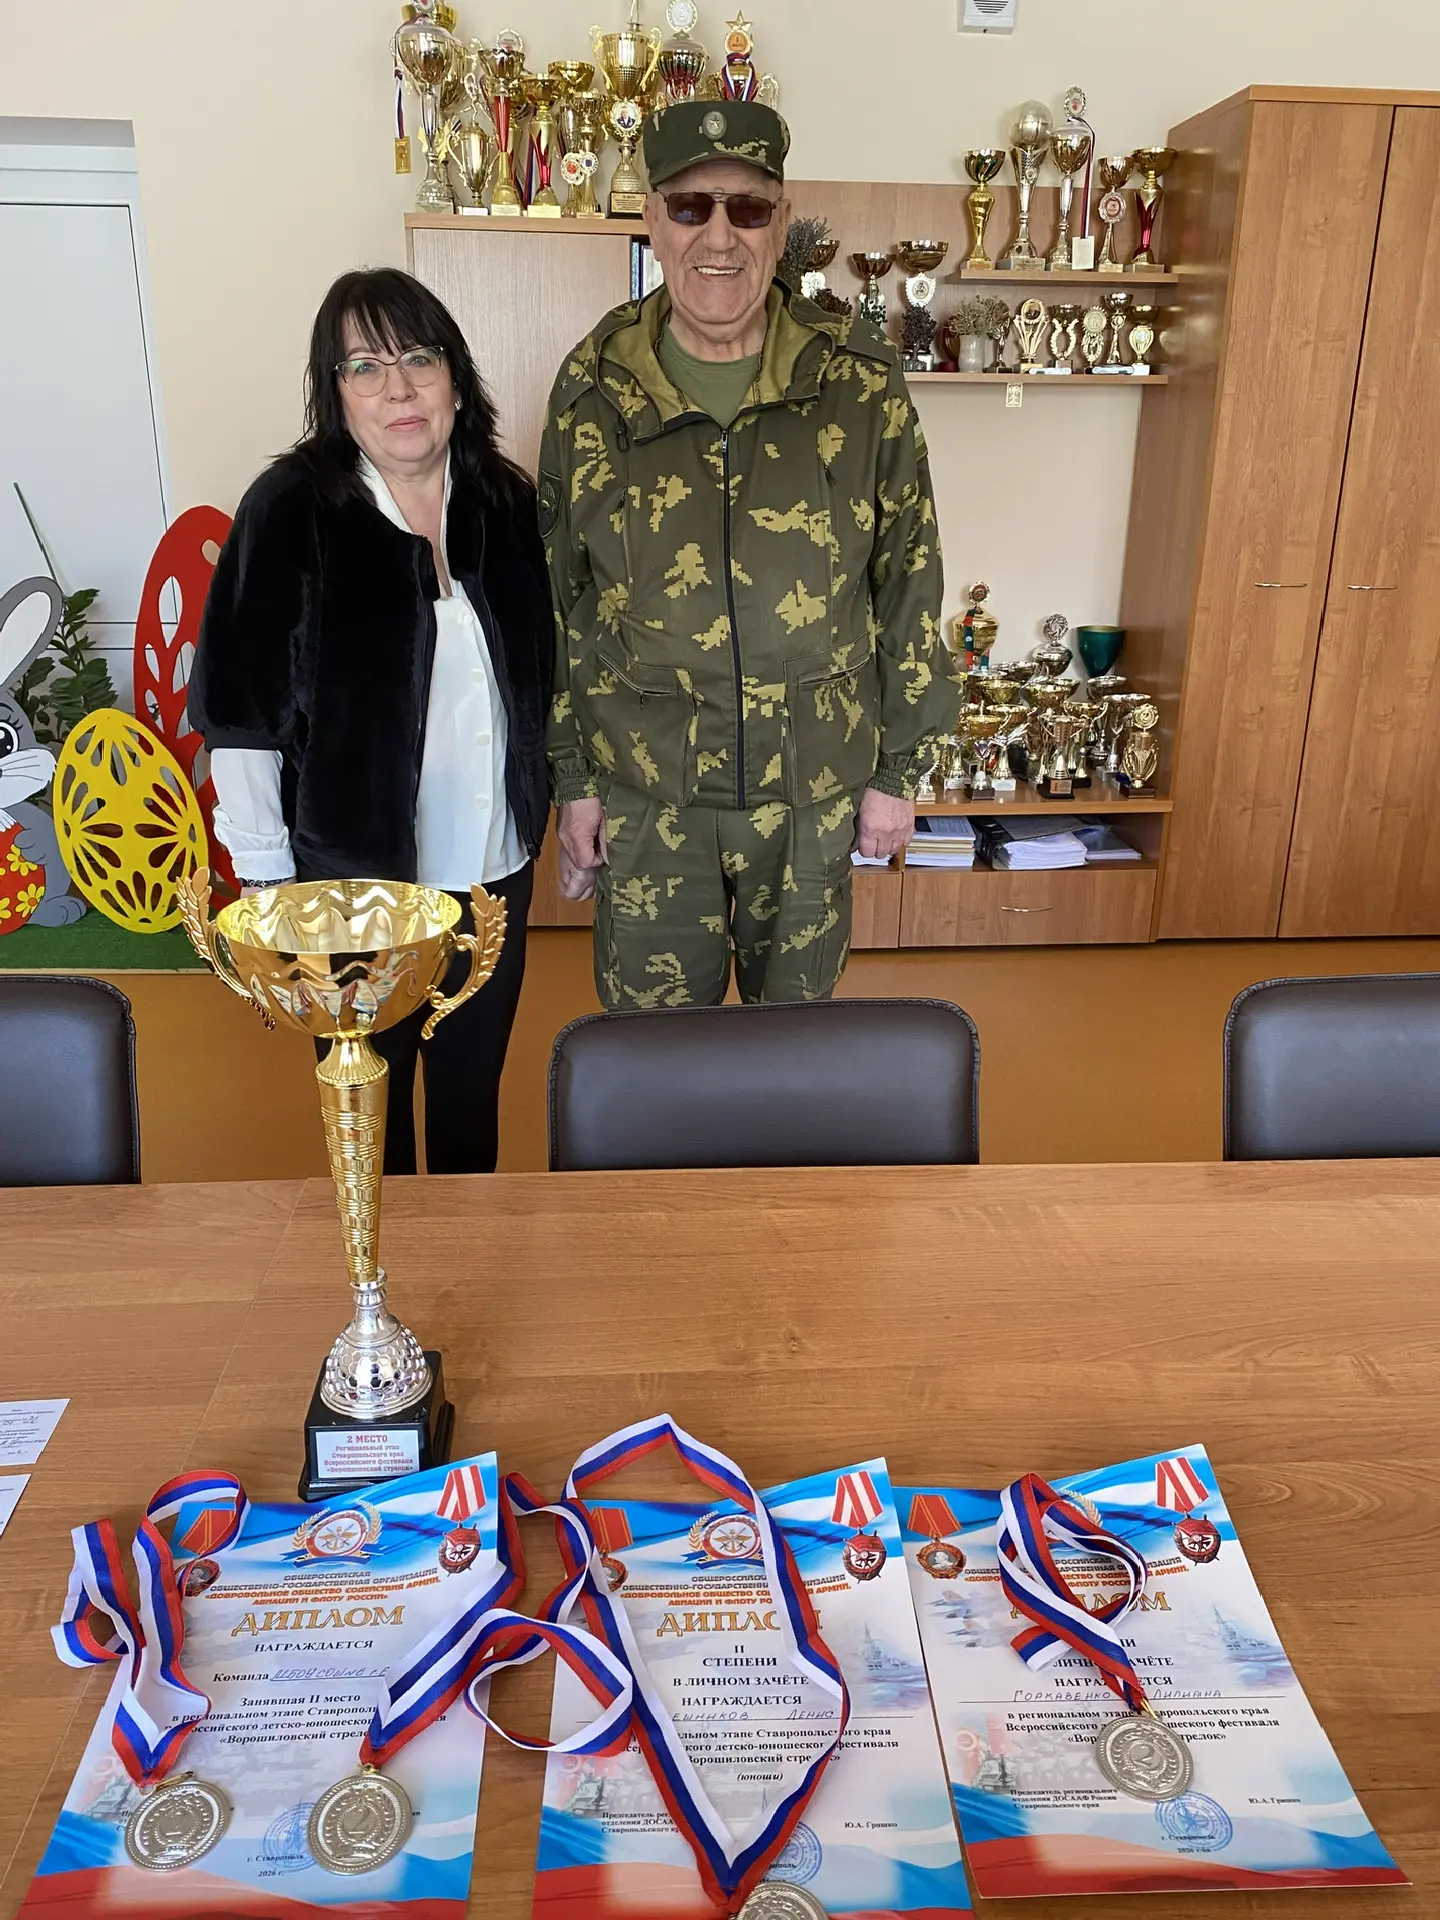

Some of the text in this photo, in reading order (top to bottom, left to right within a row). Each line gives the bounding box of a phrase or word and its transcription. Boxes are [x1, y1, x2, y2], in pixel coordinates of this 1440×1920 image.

[356, 1434, 388, 1443] МЕСТО
[331, 1452, 388, 1460] Ставропольского
[324, 1459, 377, 1467] Всероссийского
[209, 1567, 438, 1592] ОБЩЕСТВЕННО-ГОСУДАРСТВЕННАЯ ОРГАНИЗАЦИЯ
[283, 1571, 371, 1582] ОБЩЕРОССИЙСКАЯ
[291, 1587, 342, 1596] ОБЩЕСТВО
[344, 1583, 404, 1594] СОДЕЙСТВИЯ
[702, 1590, 753, 1598] ОБЩЕСТВО
[252, 1597, 299, 1606] АВИАЦИИ
[310, 1595, 344, 1604] ФЛОТУ
[724, 1598, 757, 1606] ФЛОТУ
[231, 1605, 405, 1637] ДИПЛОМ
[254, 1640, 374, 1652] НАГРАЖДАЕТСЯ
[702, 1657, 778, 1667] СТЕПЕНИ
[212, 1673, 270, 1682] Команда
[672, 1674, 809, 1687] В ЛИЧНОМ ЗАЧЁТЕ
[240, 1696, 306, 1707] Занявшая
[323, 1694, 361, 1703] место
[682, 1695, 802, 1707] НАГРАЖДАЕТСЯ
[172, 1714, 179, 1722] в
[181, 1711, 268, 1724] регональном
[271, 1709, 304, 1718] этапе
[1018, 1710, 1101, 1721] региональном
[1241, 1707, 1270, 1719] края
[260, 1718, 371, 1731] детско-юношеског
[1005, 1722, 1098, 1734] Всероссийского
[1218, 1717, 1281, 1730] фестиваля
[220, 1730, 326, 1744] «Ворошиловский
[720, 1730, 754, 1739] этапе
[863, 1728, 892, 1738] края
[736, 1771, 784, 1782] (юноши)
[1052, 1795, 1090, 1803] ДОСААФ
[602, 1811, 655, 1819] Председатель
[642, 1819, 674, 1827] ДОСАА
[844, 1821, 865, 1829] Ю.А.
[255, 1853, 305, 1862] Ставрополь
[258, 1869, 276, 1878] 2026
